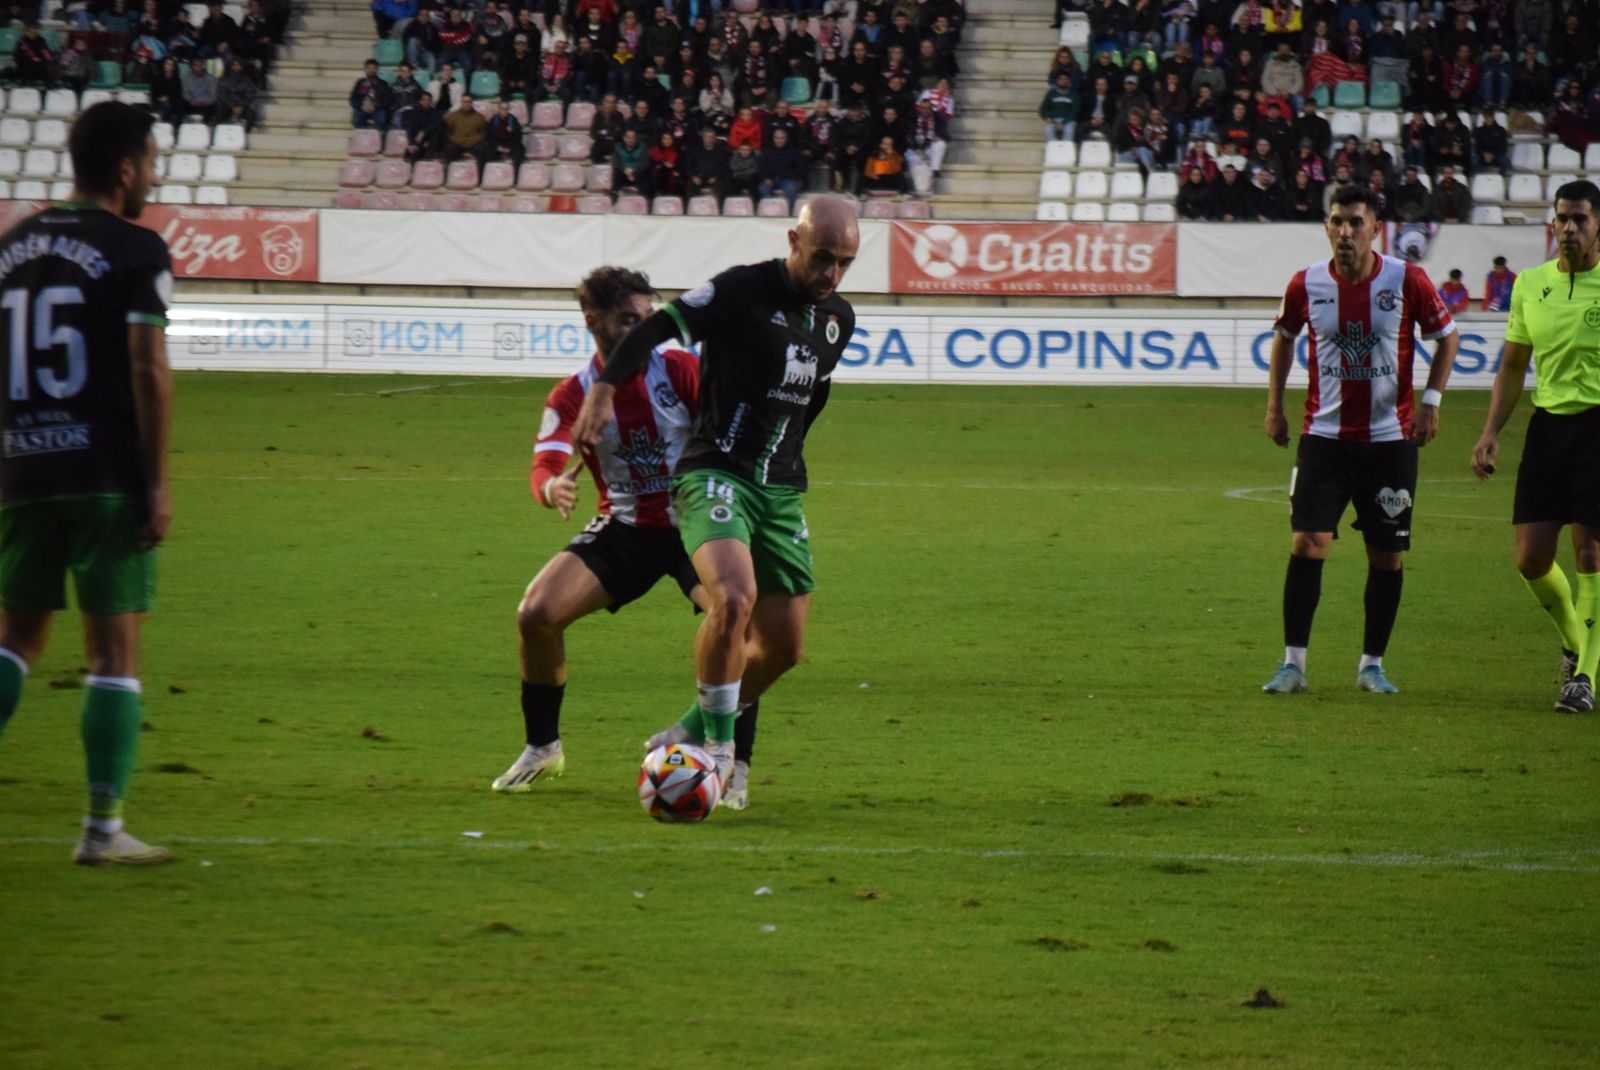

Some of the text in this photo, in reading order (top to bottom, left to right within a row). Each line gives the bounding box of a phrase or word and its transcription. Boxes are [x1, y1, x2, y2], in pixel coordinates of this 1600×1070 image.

[52, 234, 112, 280] ALVES
[977, 231, 1155, 274] Cualtis
[1, 285, 88, 400] 15
[225, 318, 312, 350] HGM
[380, 320, 465, 352] HGM
[944, 328, 1220, 371] COPINSA
[1349, 364, 1394, 380] RURAL
[706, 476, 735, 505] 14
